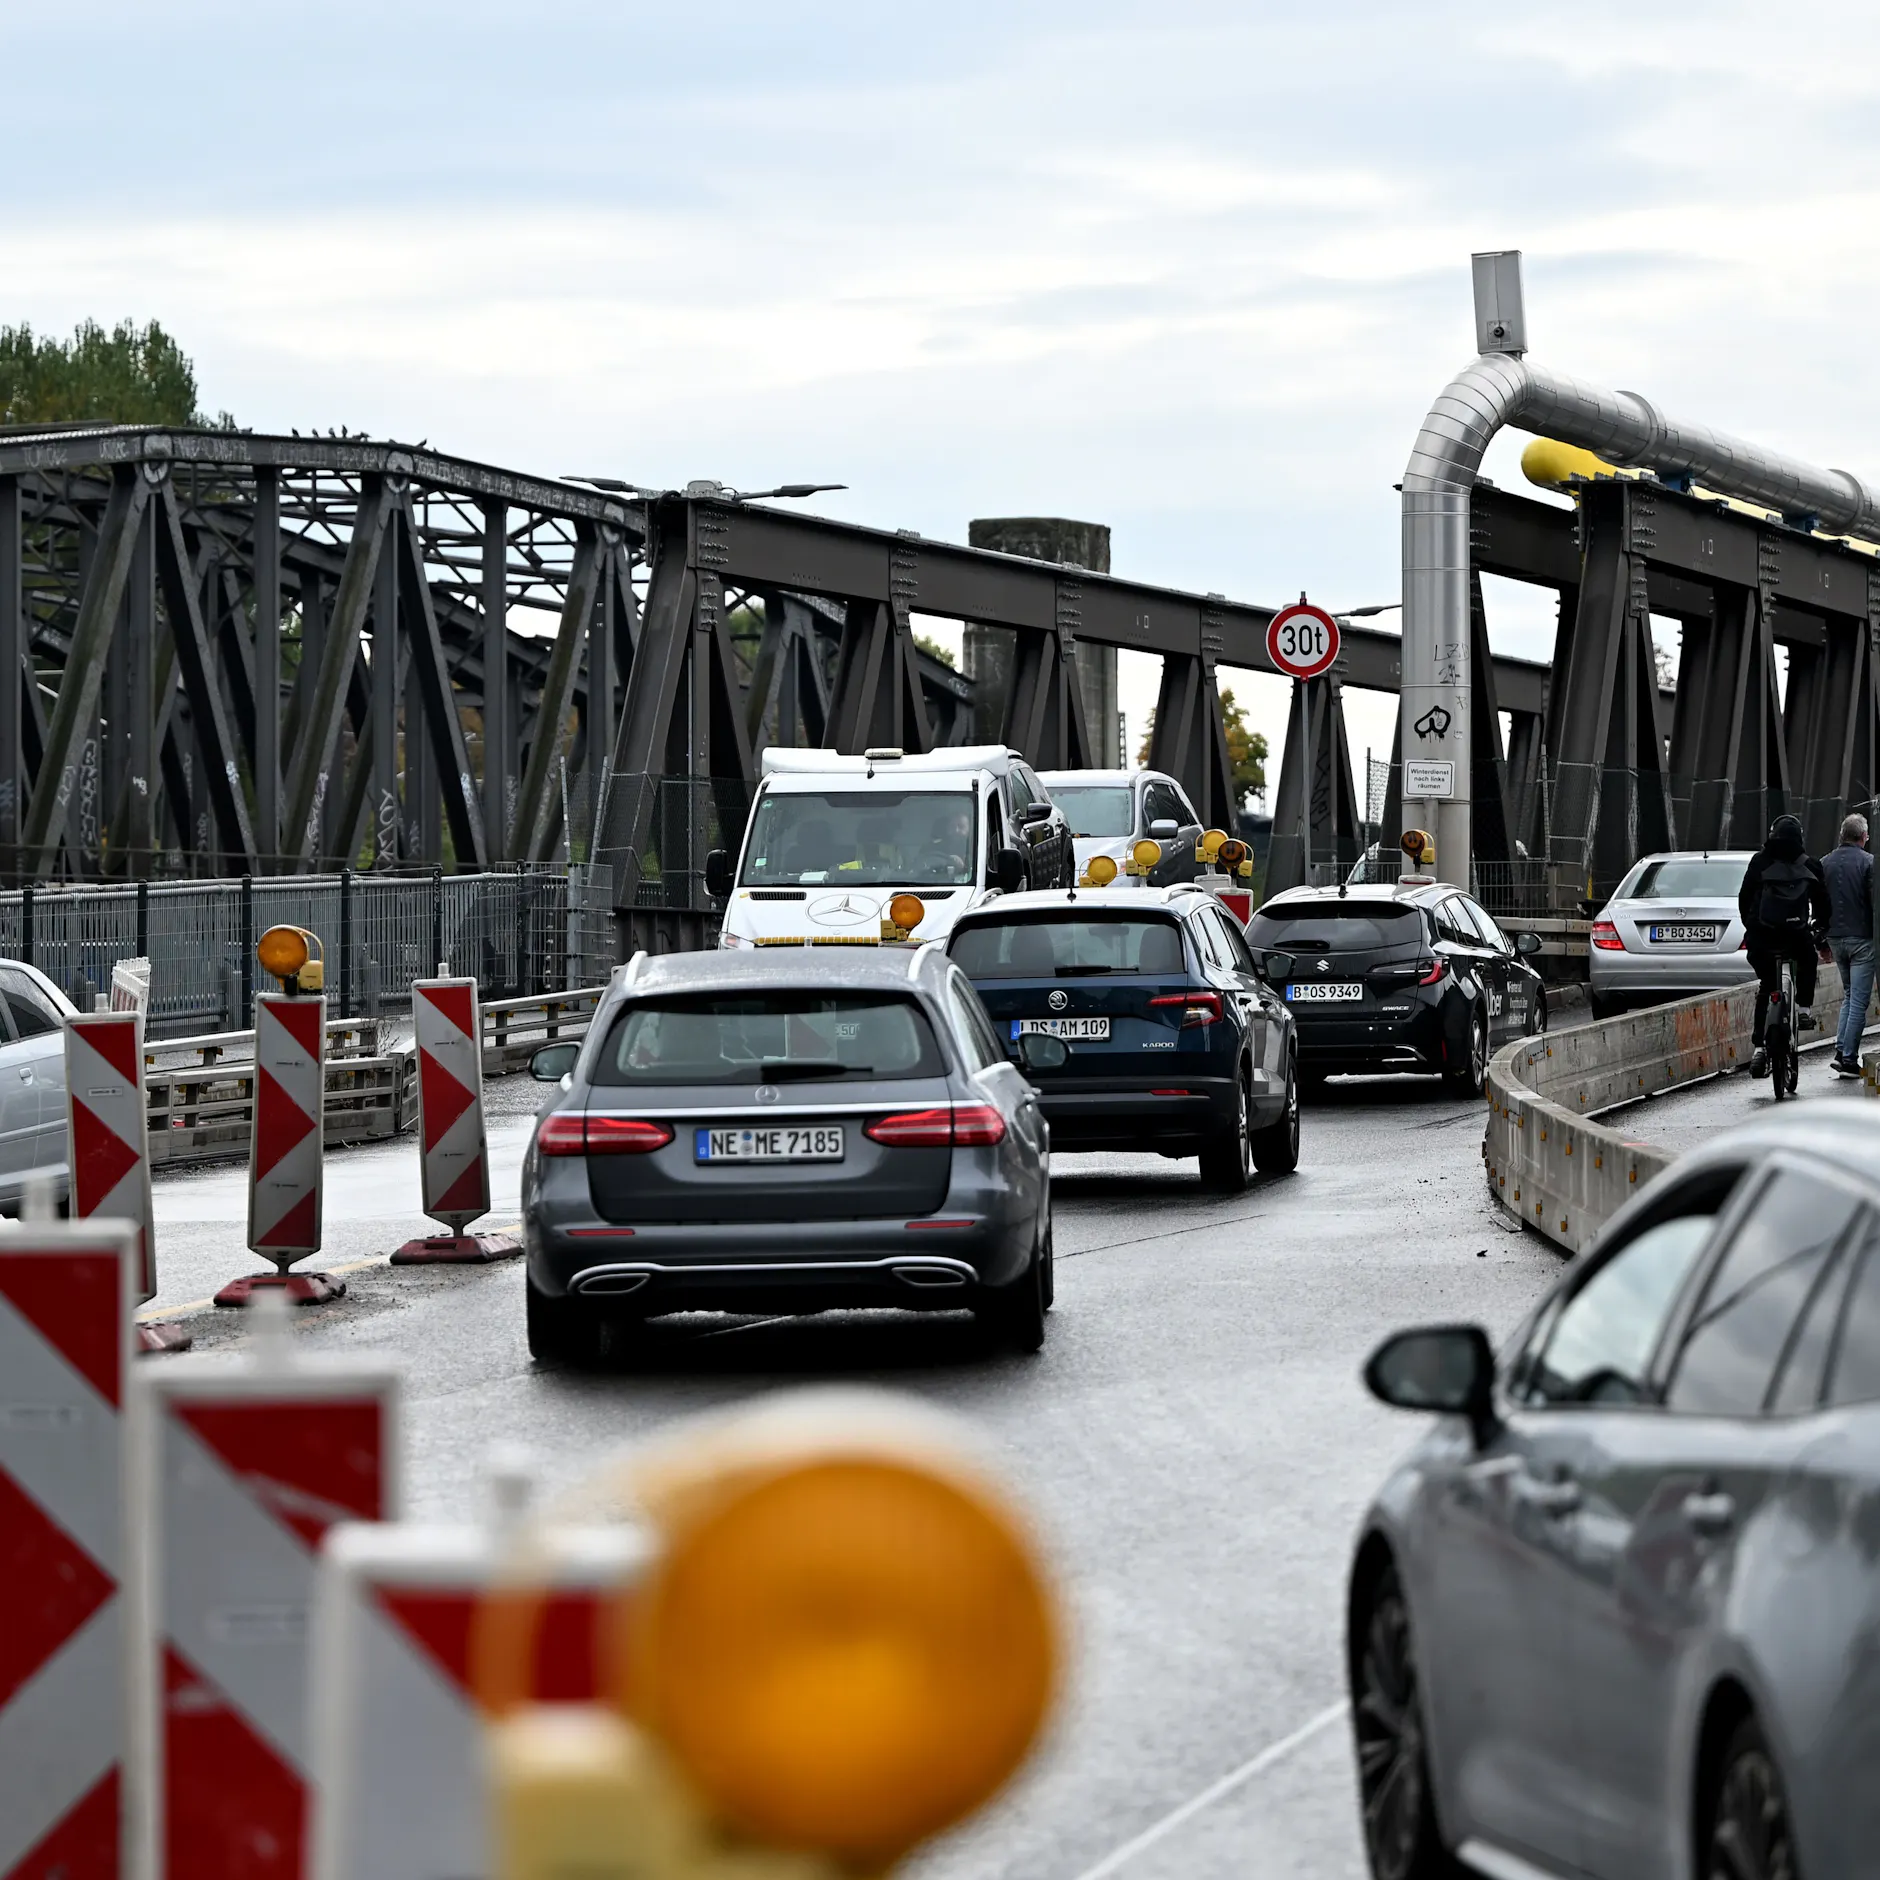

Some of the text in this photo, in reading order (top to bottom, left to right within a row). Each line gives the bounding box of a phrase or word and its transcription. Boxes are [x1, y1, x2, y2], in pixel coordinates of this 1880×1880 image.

[1282, 625, 1323, 656] 30t
[1658, 928, 1712, 938] B BQ 3454
[1294, 986, 1301, 998] B
[1310, 986, 1326, 998] OS
[1329, 986, 1360, 998] 9349
[1486, 988, 1502, 1016] Uber
[1060, 1020, 1077, 1036] AM
[1081, 1019, 1107, 1036] 109
[711, 1132, 738, 1154] NE
[755, 1131, 782, 1154] ME
[787, 1130, 840, 1153] 7185
